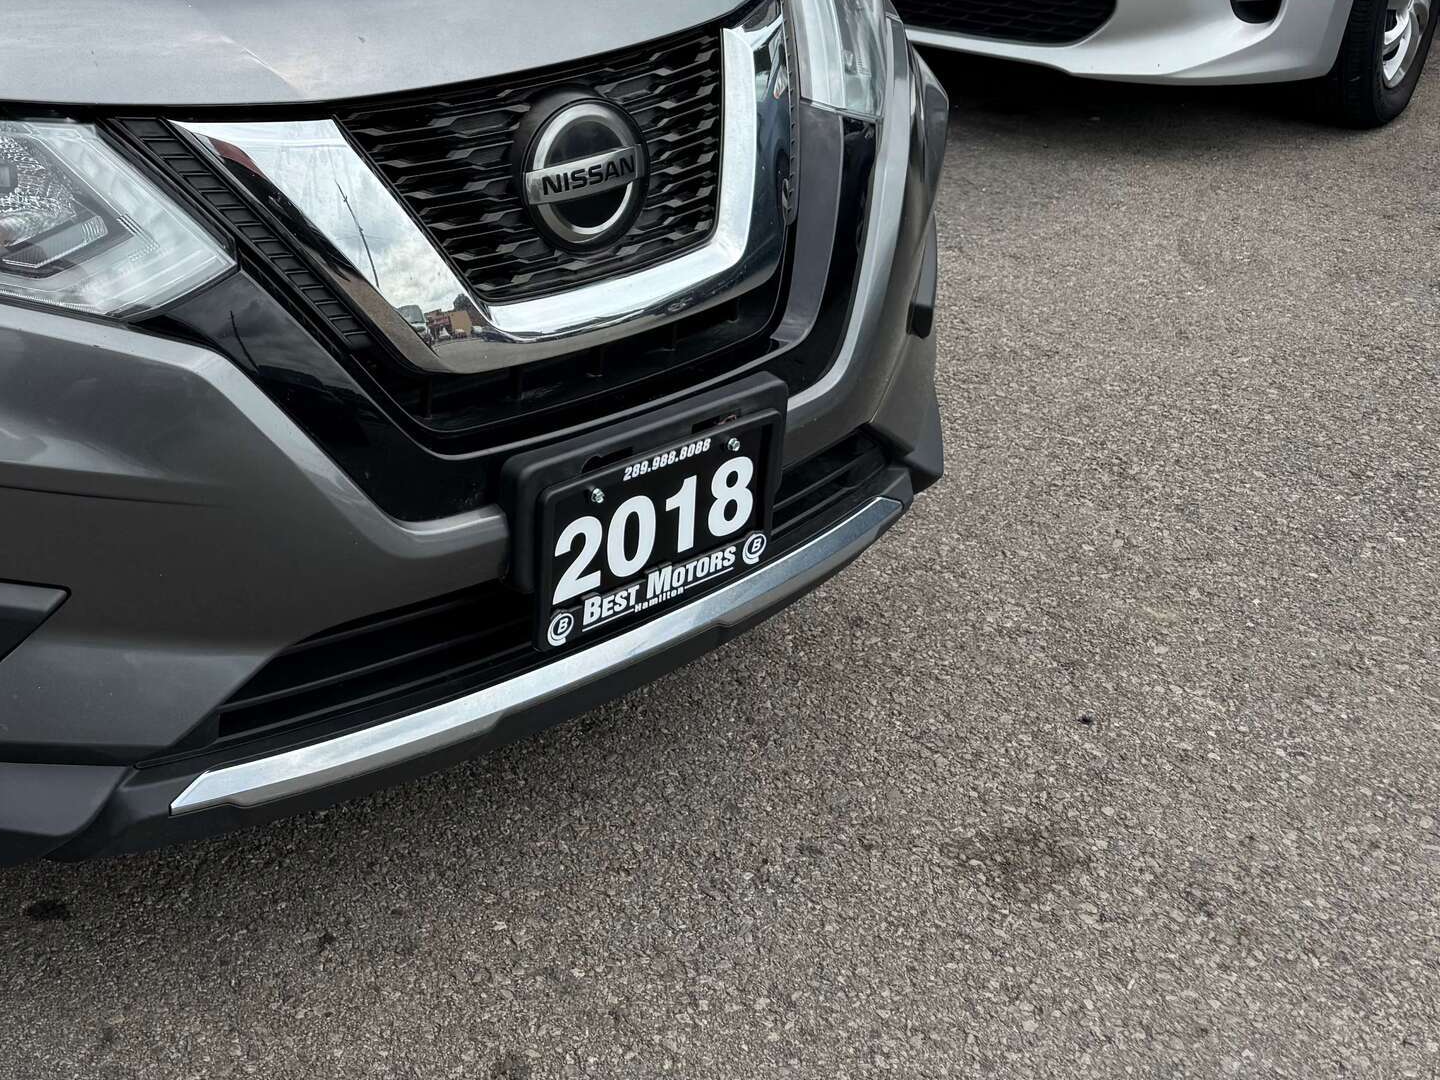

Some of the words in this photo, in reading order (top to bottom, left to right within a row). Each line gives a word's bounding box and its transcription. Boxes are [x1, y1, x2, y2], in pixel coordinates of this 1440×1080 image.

[541, 155, 635, 196] NISSAN
[623, 438, 712, 481] 289.988.8088
[552, 456, 754, 605] 2018
[582, 585, 640, 626] BEST
[646, 545, 737, 599] MOTORS
[634, 585, 684, 613] Hamilton
